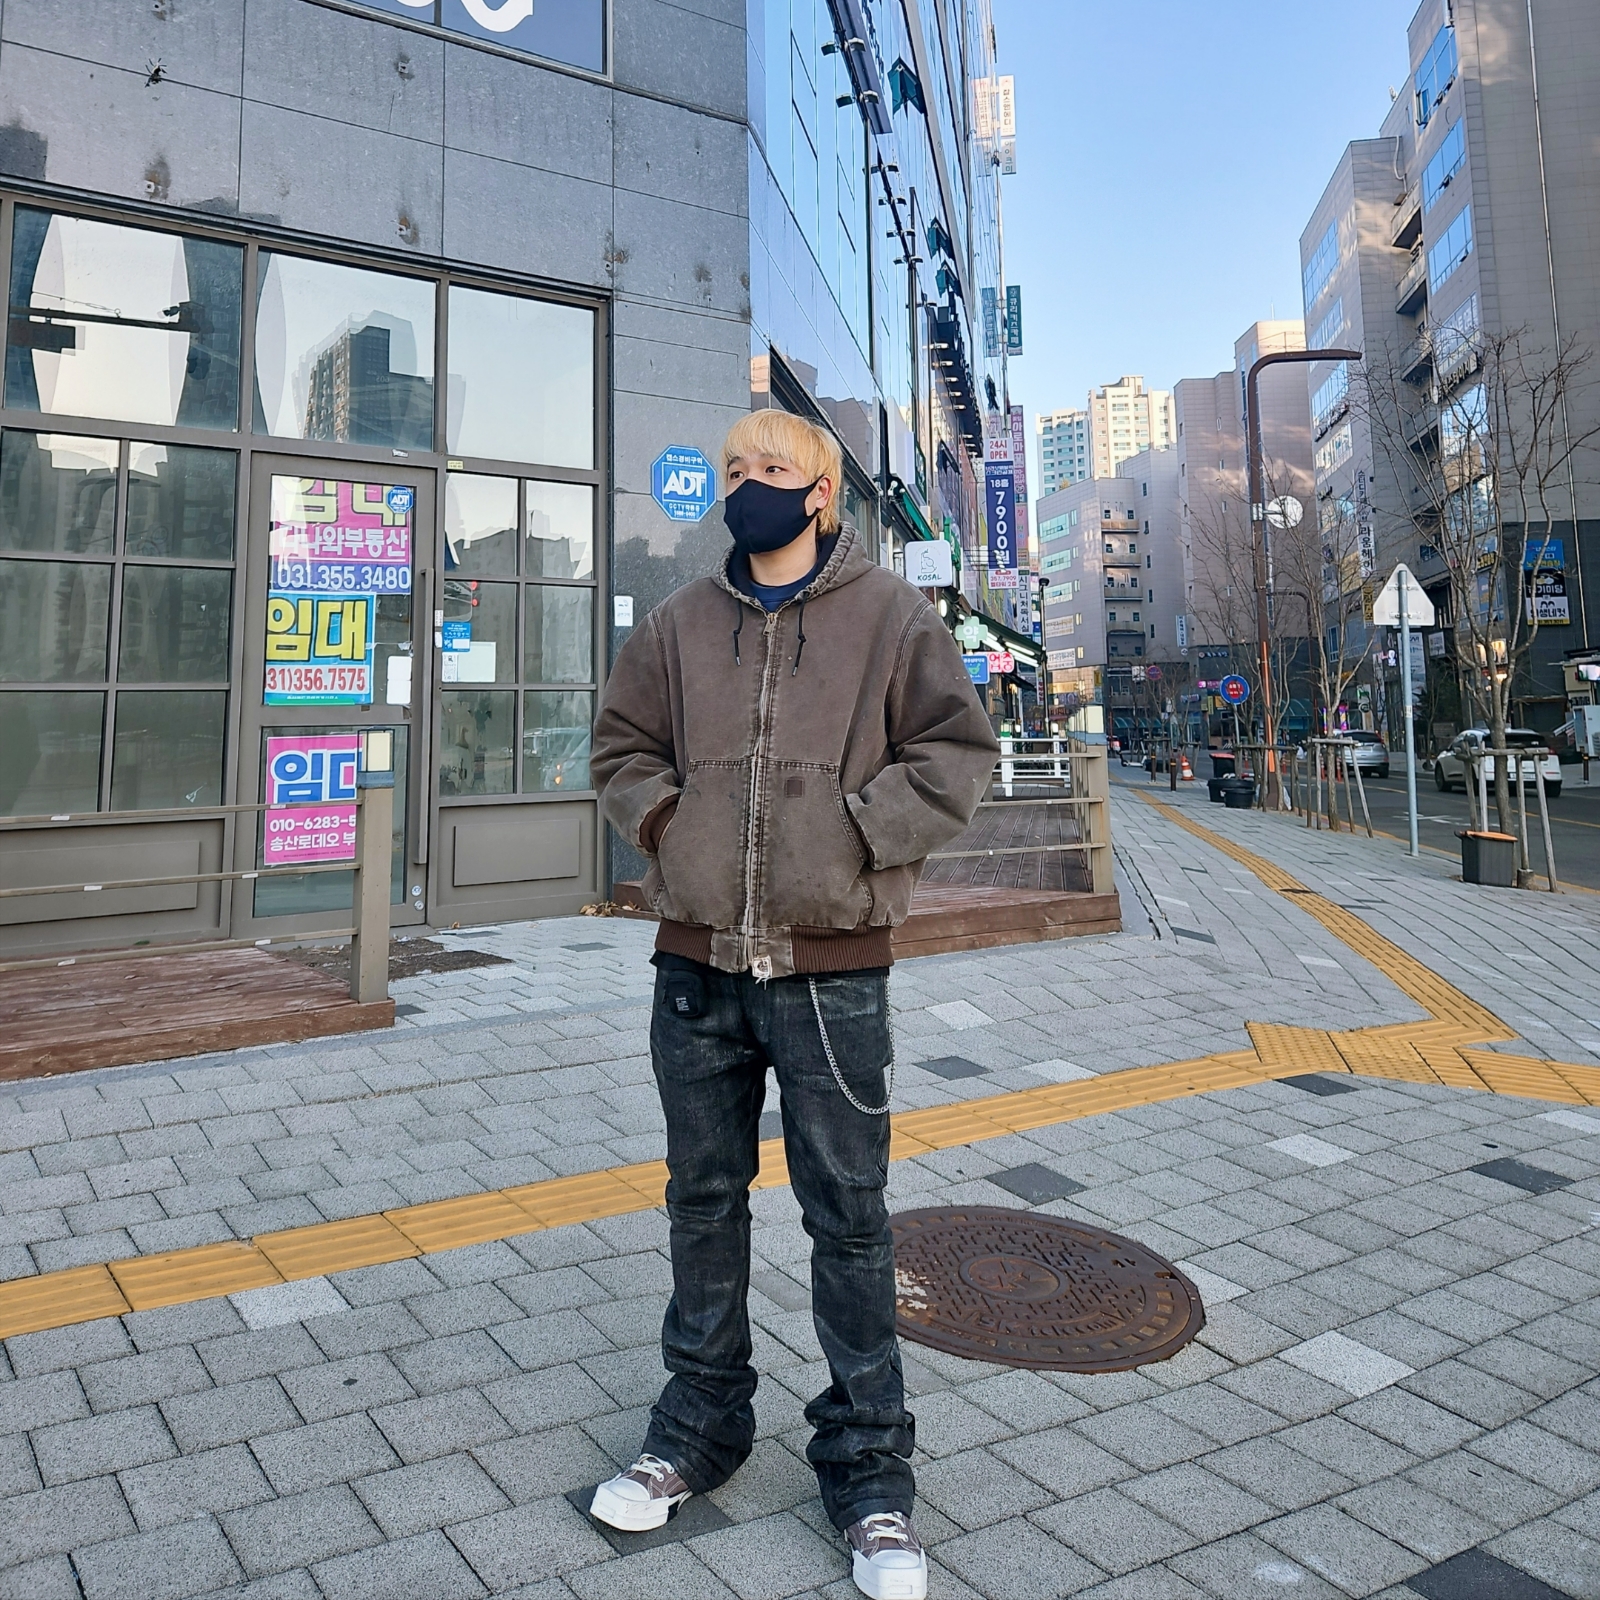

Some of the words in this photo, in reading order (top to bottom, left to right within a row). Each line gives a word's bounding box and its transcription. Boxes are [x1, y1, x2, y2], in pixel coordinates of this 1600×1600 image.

[990, 440, 1007, 449] 24시
[1012, 421, 1025, 452] 아로마
[990, 451, 1008, 460] OPEN
[663, 469, 706, 498] ADT
[990, 478, 1009, 488] 18홀
[390, 494, 410, 505] ADT
[277, 564, 411, 590] 031.355.3480
[266, 596, 368, 662] 임대
[963, 626, 979, 643] 약
[265, 668, 366, 691] 31)356.7575
[270, 814, 356, 832] 010-6283-5
[270, 833, 339, 852] 송산로데오
[342, 831, 356, 846] 부
[1028, 1318, 1118, 1337] telecom
